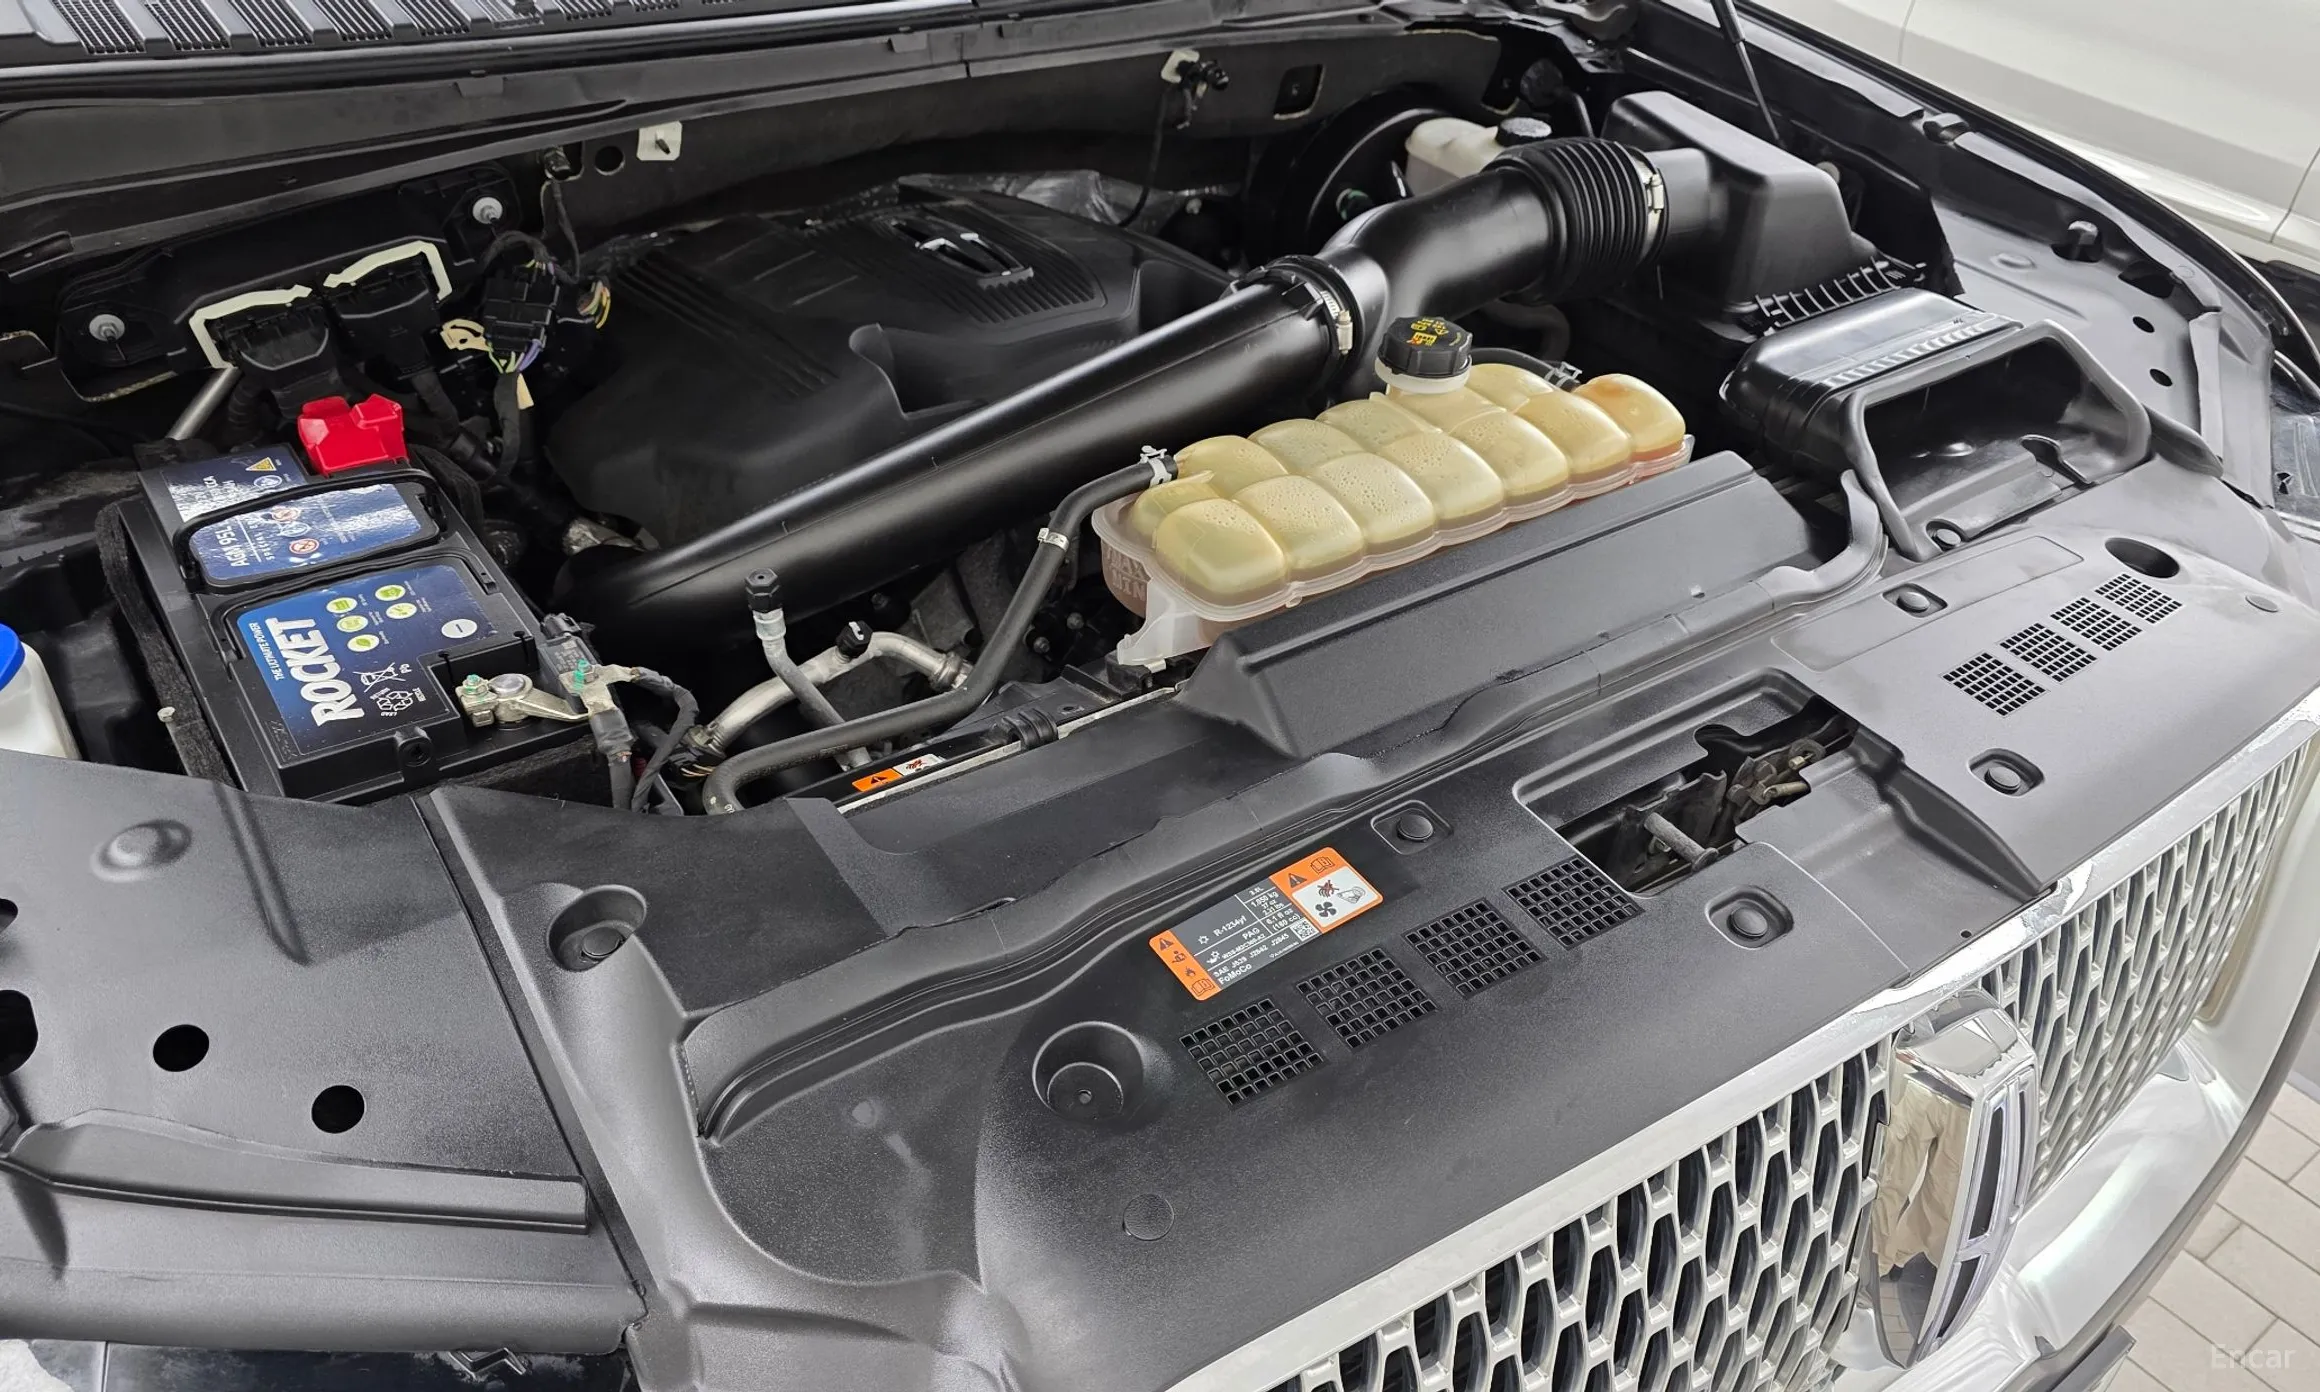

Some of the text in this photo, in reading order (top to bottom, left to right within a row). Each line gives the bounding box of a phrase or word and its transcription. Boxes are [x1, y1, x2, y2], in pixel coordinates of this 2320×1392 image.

[222, 545, 250, 567] AGM
[1112, 569, 1146, 601] MIN
[249, 622, 285, 681] THE ULTIMATE POWER
[265, 617, 365, 727] ROCKET
[1268, 891, 1279, 899] kg
[1213, 915, 1247, 937] R-1234yf
[1288, 913, 1301, 923] cc)
[1242, 927, 1260, 940] PAG
[1213, 965, 1230, 978] SAE
[1217, 963, 1253, 985] FoMoCo
